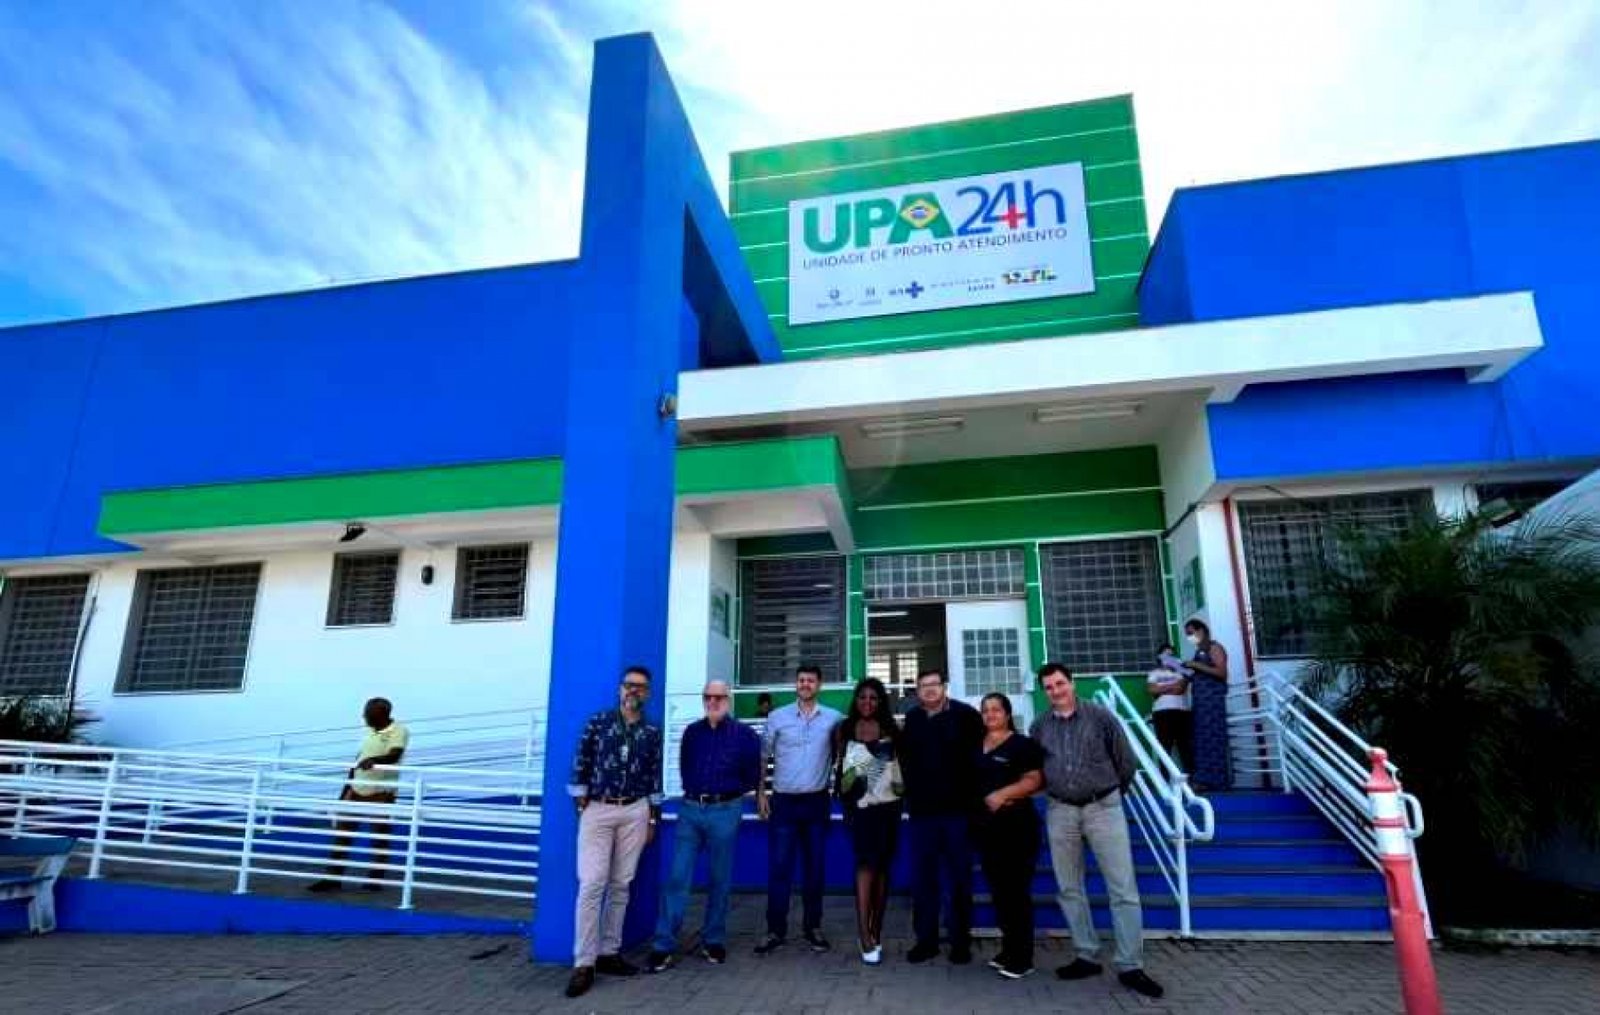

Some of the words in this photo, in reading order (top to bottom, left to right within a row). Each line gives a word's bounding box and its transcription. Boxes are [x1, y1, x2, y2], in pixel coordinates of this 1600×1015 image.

[803, 191, 955, 254] UPA
[957, 179, 1067, 237] 24h
[803, 255, 863, 269] UNIDADE
[871, 249, 886, 261] DE
[894, 241, 952, 257] PRONTO
[957, 228, 1067, 250] ATENDIMENTO
